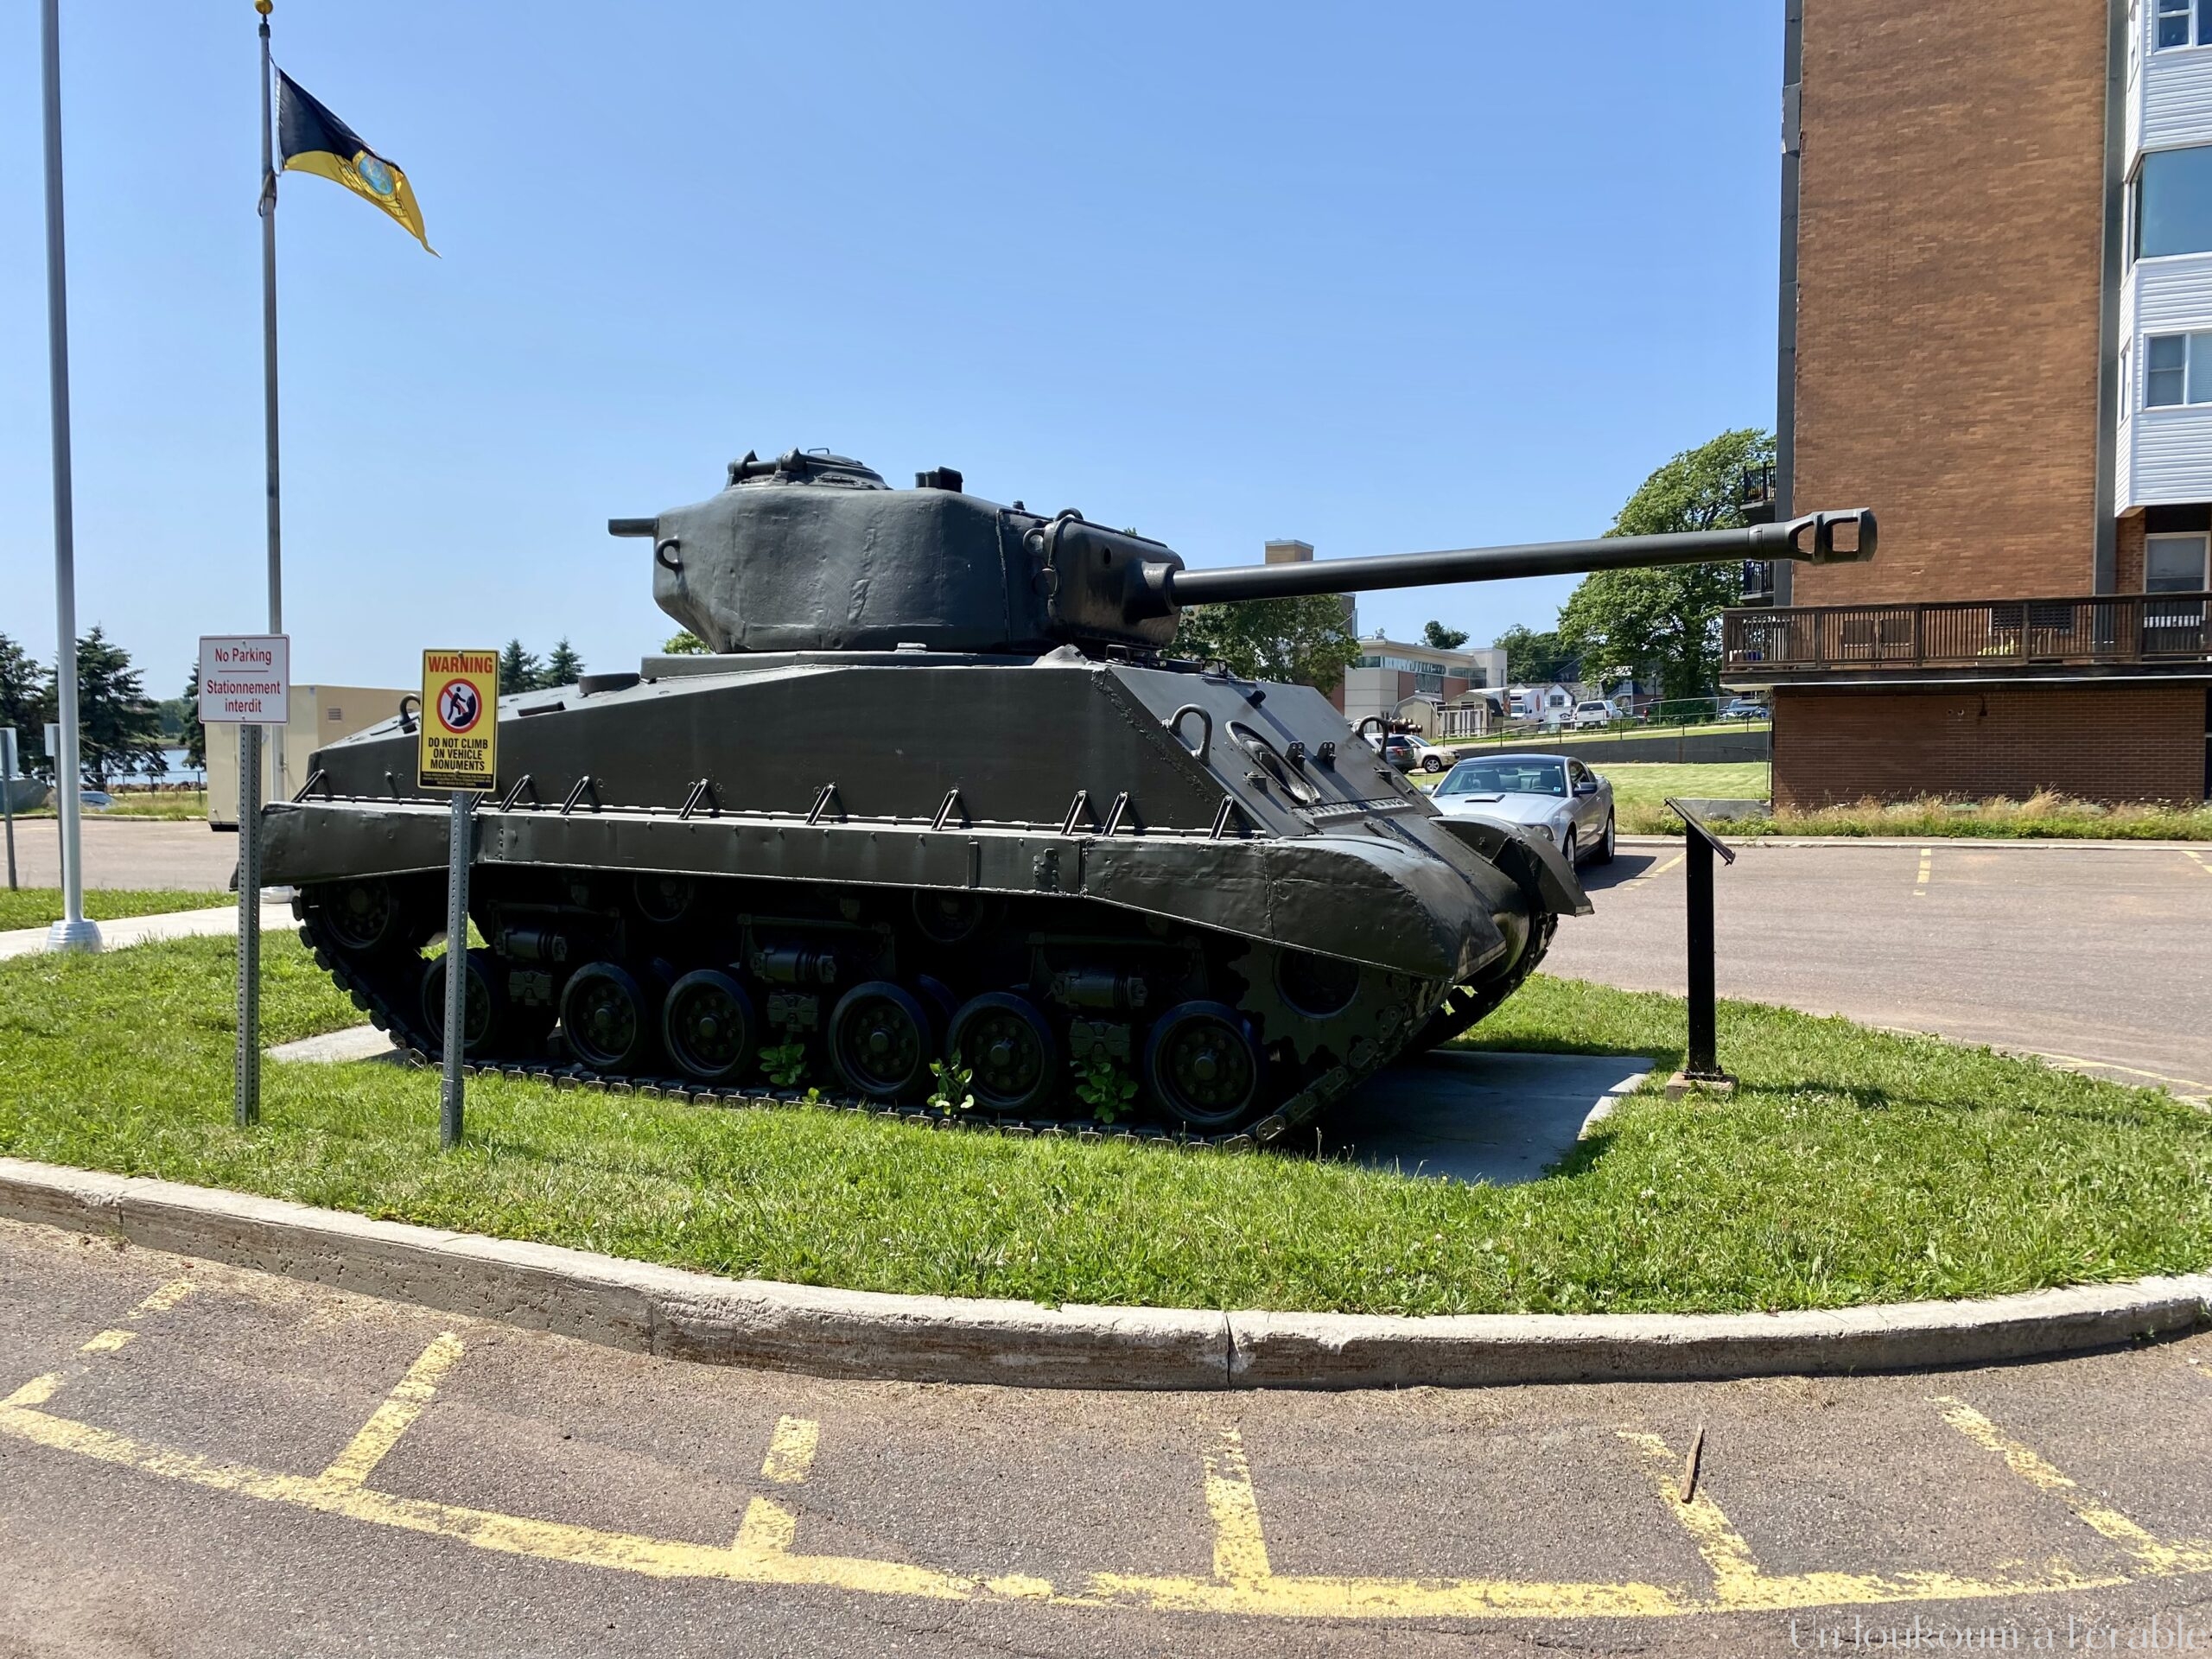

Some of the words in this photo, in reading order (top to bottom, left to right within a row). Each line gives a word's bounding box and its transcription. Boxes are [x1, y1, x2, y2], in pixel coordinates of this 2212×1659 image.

[215, 648, 229, 662] No
[232, 647, 272, 665] Parking
[428, 656, 493, 673] WARNING
[207, 680, 281, 694] Stationnement
[225, 698, 262, 712] interdit
[429, 737, 440, 747] DO
[442, 738, 459, 748] NOT
[461, 738, 488, 749] CLIMB
[433, 748, 445, 758] ON
[448, 748, 483, 760] VEHICLE
[430, 760, 485, 771] MONUMENTS
